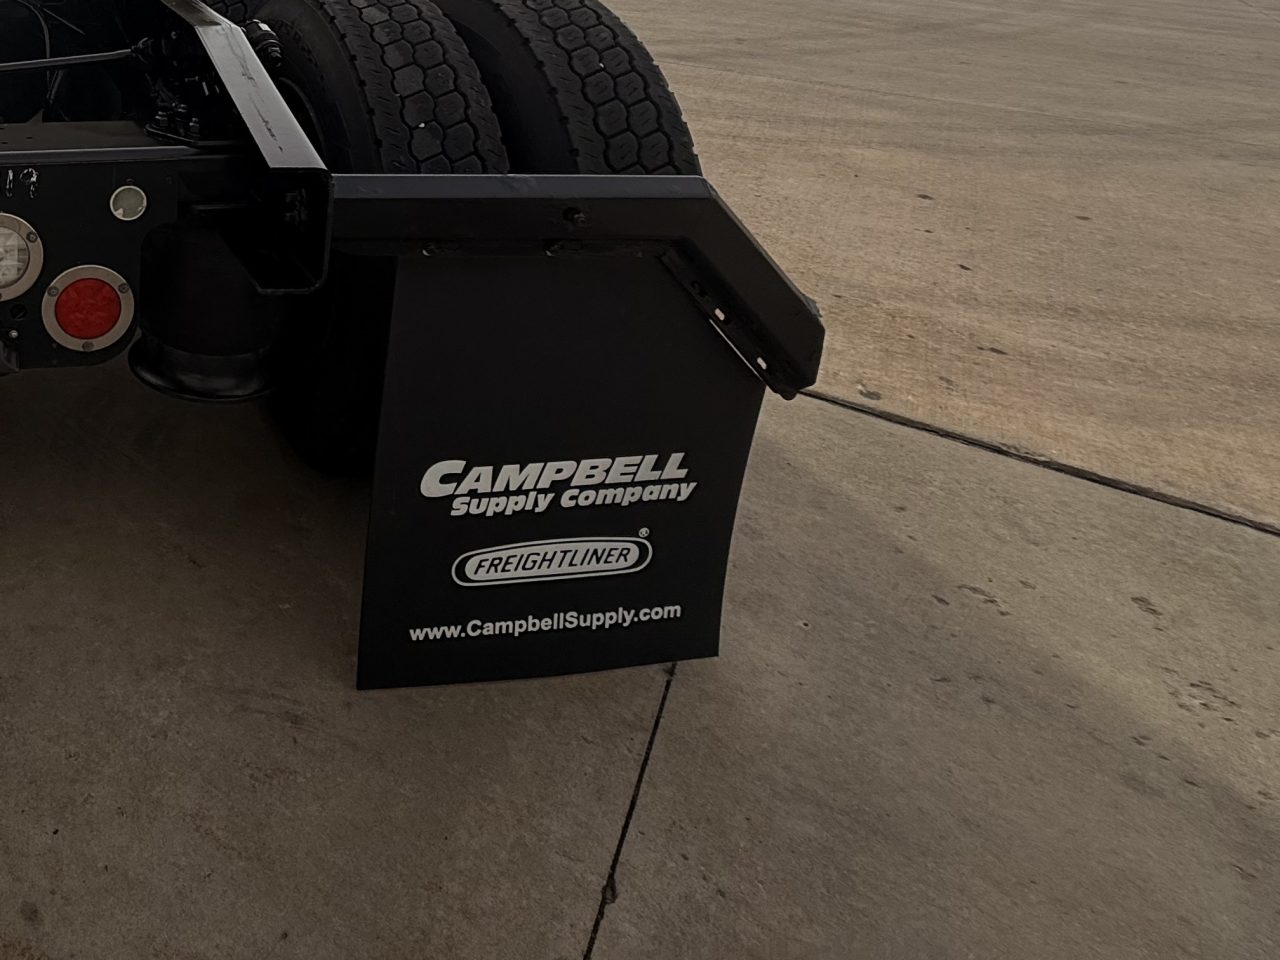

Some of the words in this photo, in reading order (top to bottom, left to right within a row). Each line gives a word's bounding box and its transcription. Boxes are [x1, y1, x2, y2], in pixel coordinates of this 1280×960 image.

[420, 452, 689, 498] CAMPBELL
[450, 491, 555, 517] Supply
[473, 547, 632, 576] FREIGHTLINER
[409, 604, 682, 641] www.CampbellSupply.com
